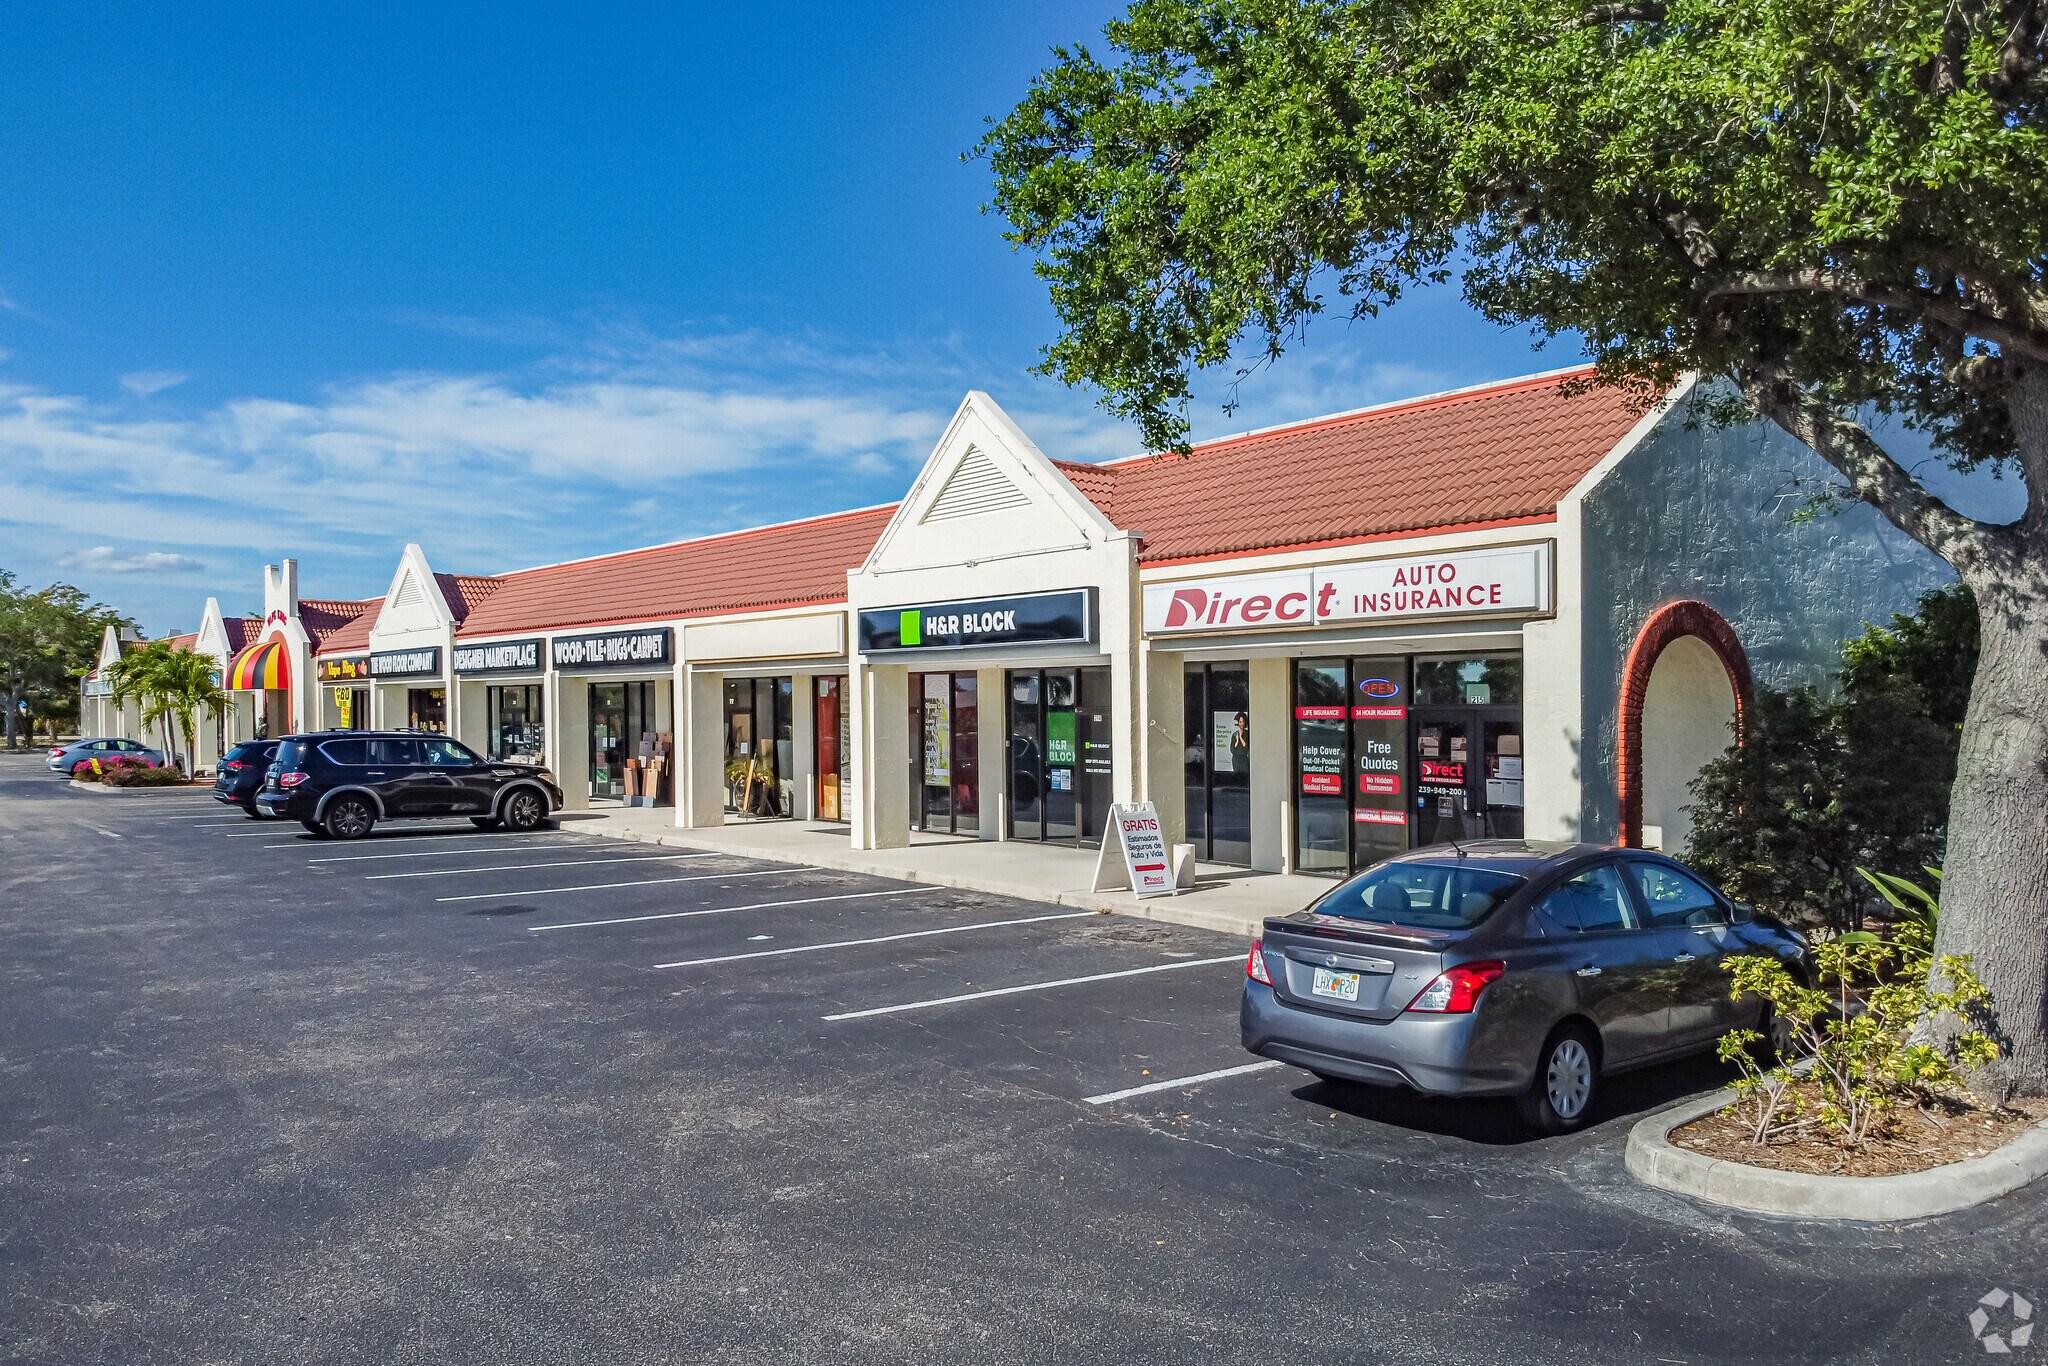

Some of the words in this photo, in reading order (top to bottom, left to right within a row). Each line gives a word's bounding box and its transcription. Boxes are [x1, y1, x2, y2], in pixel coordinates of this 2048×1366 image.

[1393, 563, 1456, 587] AUTO
[1164, 582, 1338, 628] Direct
[1354, 584, 1501, 614] INSURANCE
[926, 614, 959, 636] H&R
[963, 610, 1016, 634] BLOCK
[370, 656, 379, 674] THE
[379, 655, 392, 674] WOOD
[392, 654, 408, 672] FLOOR
[408, 652, 433, 671] COMPANY
[454, 648, 485, 670] DESIGNER
[485, 644, 536, 668] MARKETPLACE
[1362, 682, 1395, 695] OPEN
[1471, 696, 1484, 704] 215
[1049, 739, 1067, 750] H&R
[1302, 745, 1318, 756] Help
[1319, 745, 1340, 756] Cover
[1367, 740, 1392, 754] Free
[1302, 757, 1340, 766] Out-Of-Pocket
[1361, 756, 1399, 770] Quotes
[1303, 765, 1324, 773] Medical
[1324, 766, 1340, 774] Costs
[1421, 761, 1464, 777] Direct
[1366, 776, 1374, 784] No
[1374, 776, 1394, 784] Hidden
[1321, 784, 1340, 792] Expense
[1366, 784, 1393, 792] Nonsense
[1123, 819, 1157, 831] GRATIS
[1128, 843, 1153, 852] Seguros
[1145, 852, 1149, 860] y
[1149, 850, 1164, 858] Vida
